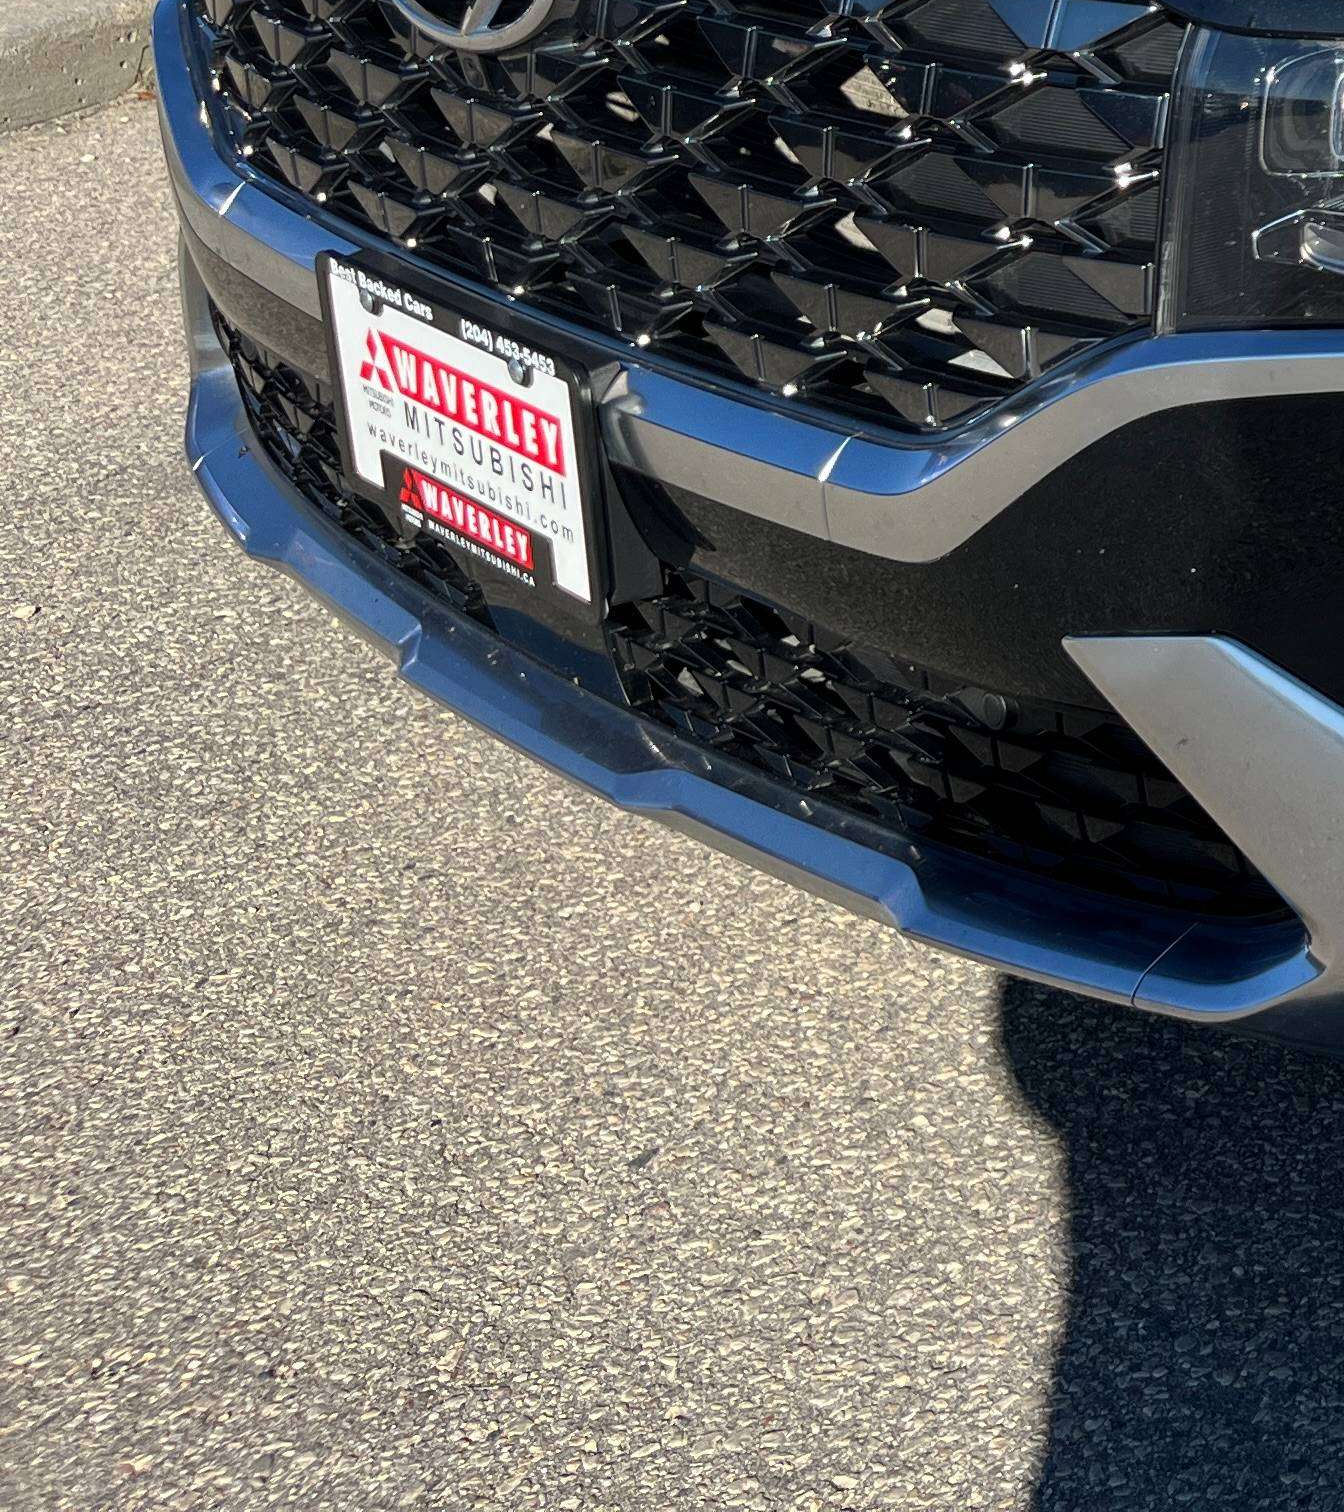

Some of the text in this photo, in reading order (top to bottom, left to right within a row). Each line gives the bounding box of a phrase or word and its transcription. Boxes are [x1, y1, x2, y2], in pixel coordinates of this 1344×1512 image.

[330, 257, 556, 377] Best Backed Cars (204) 453-5453
[391, 342, 561, 466] WAVERLEY
[403, 400, 567, 510] MITSUBISHI
[367, 422, 575, 543] waverleymitsubishi.com
[420, 475, 529, 564] WAVERLEY
